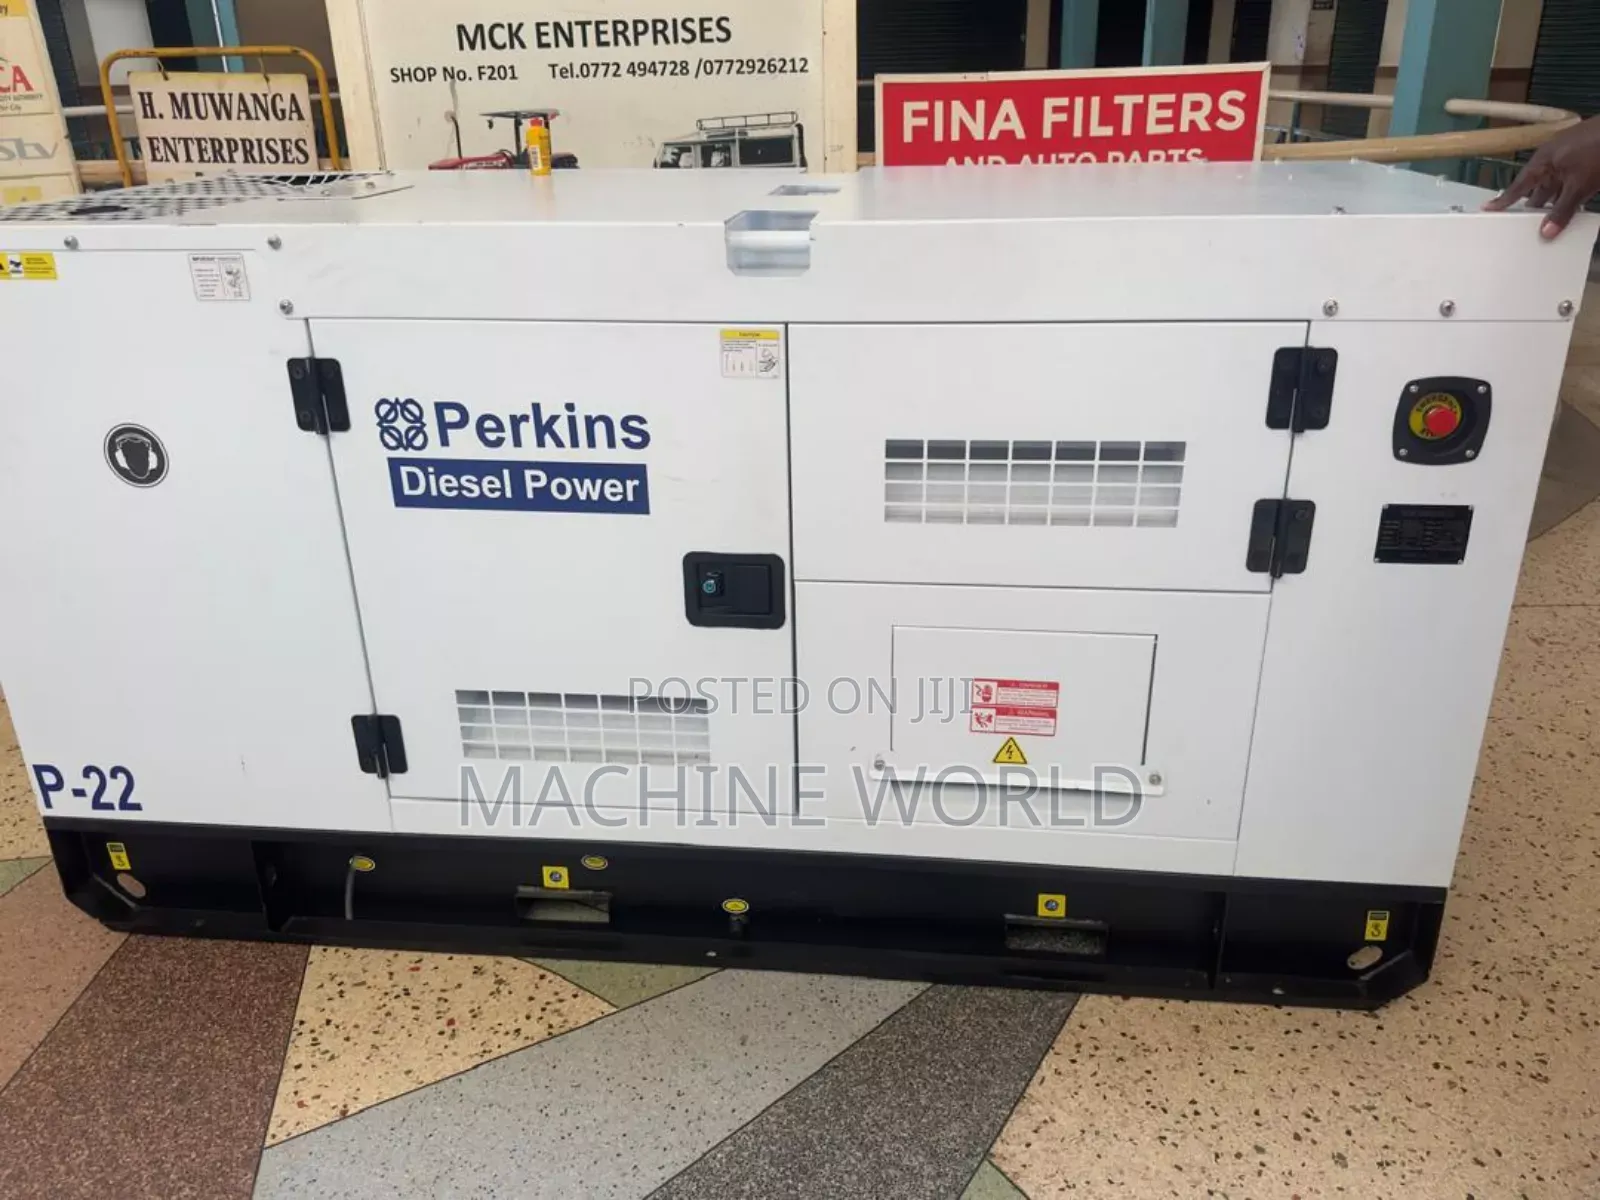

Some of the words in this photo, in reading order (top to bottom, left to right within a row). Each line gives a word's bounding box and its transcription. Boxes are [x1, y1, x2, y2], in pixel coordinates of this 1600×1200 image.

[455, 22, 527, 51] MCK
[535, 16, 732, 48] ENTERPRISES
[390, 66, 437, 83] SHOP
[442, 66, 473, 82] No.
[477, 65, 518, 81] F201
[548, 62, 622, 79] Tel.0772
[626, 60, 690, 77] 494728
[694, 57, 809, 79] /0772926212
[138, 91, 164, 119] H.
[168, 92, 305, 121] MUWANGA
[902, 98, 1026, 143] FINA
[1042, 89, 1247, 139] FILTERS
[147, 136, 310, 164] ENTERPRISES
[434, 401, 651, 450] Perkins
[400, 466, 512, 499] Diesel
[524, 469, 640, 502] Power
